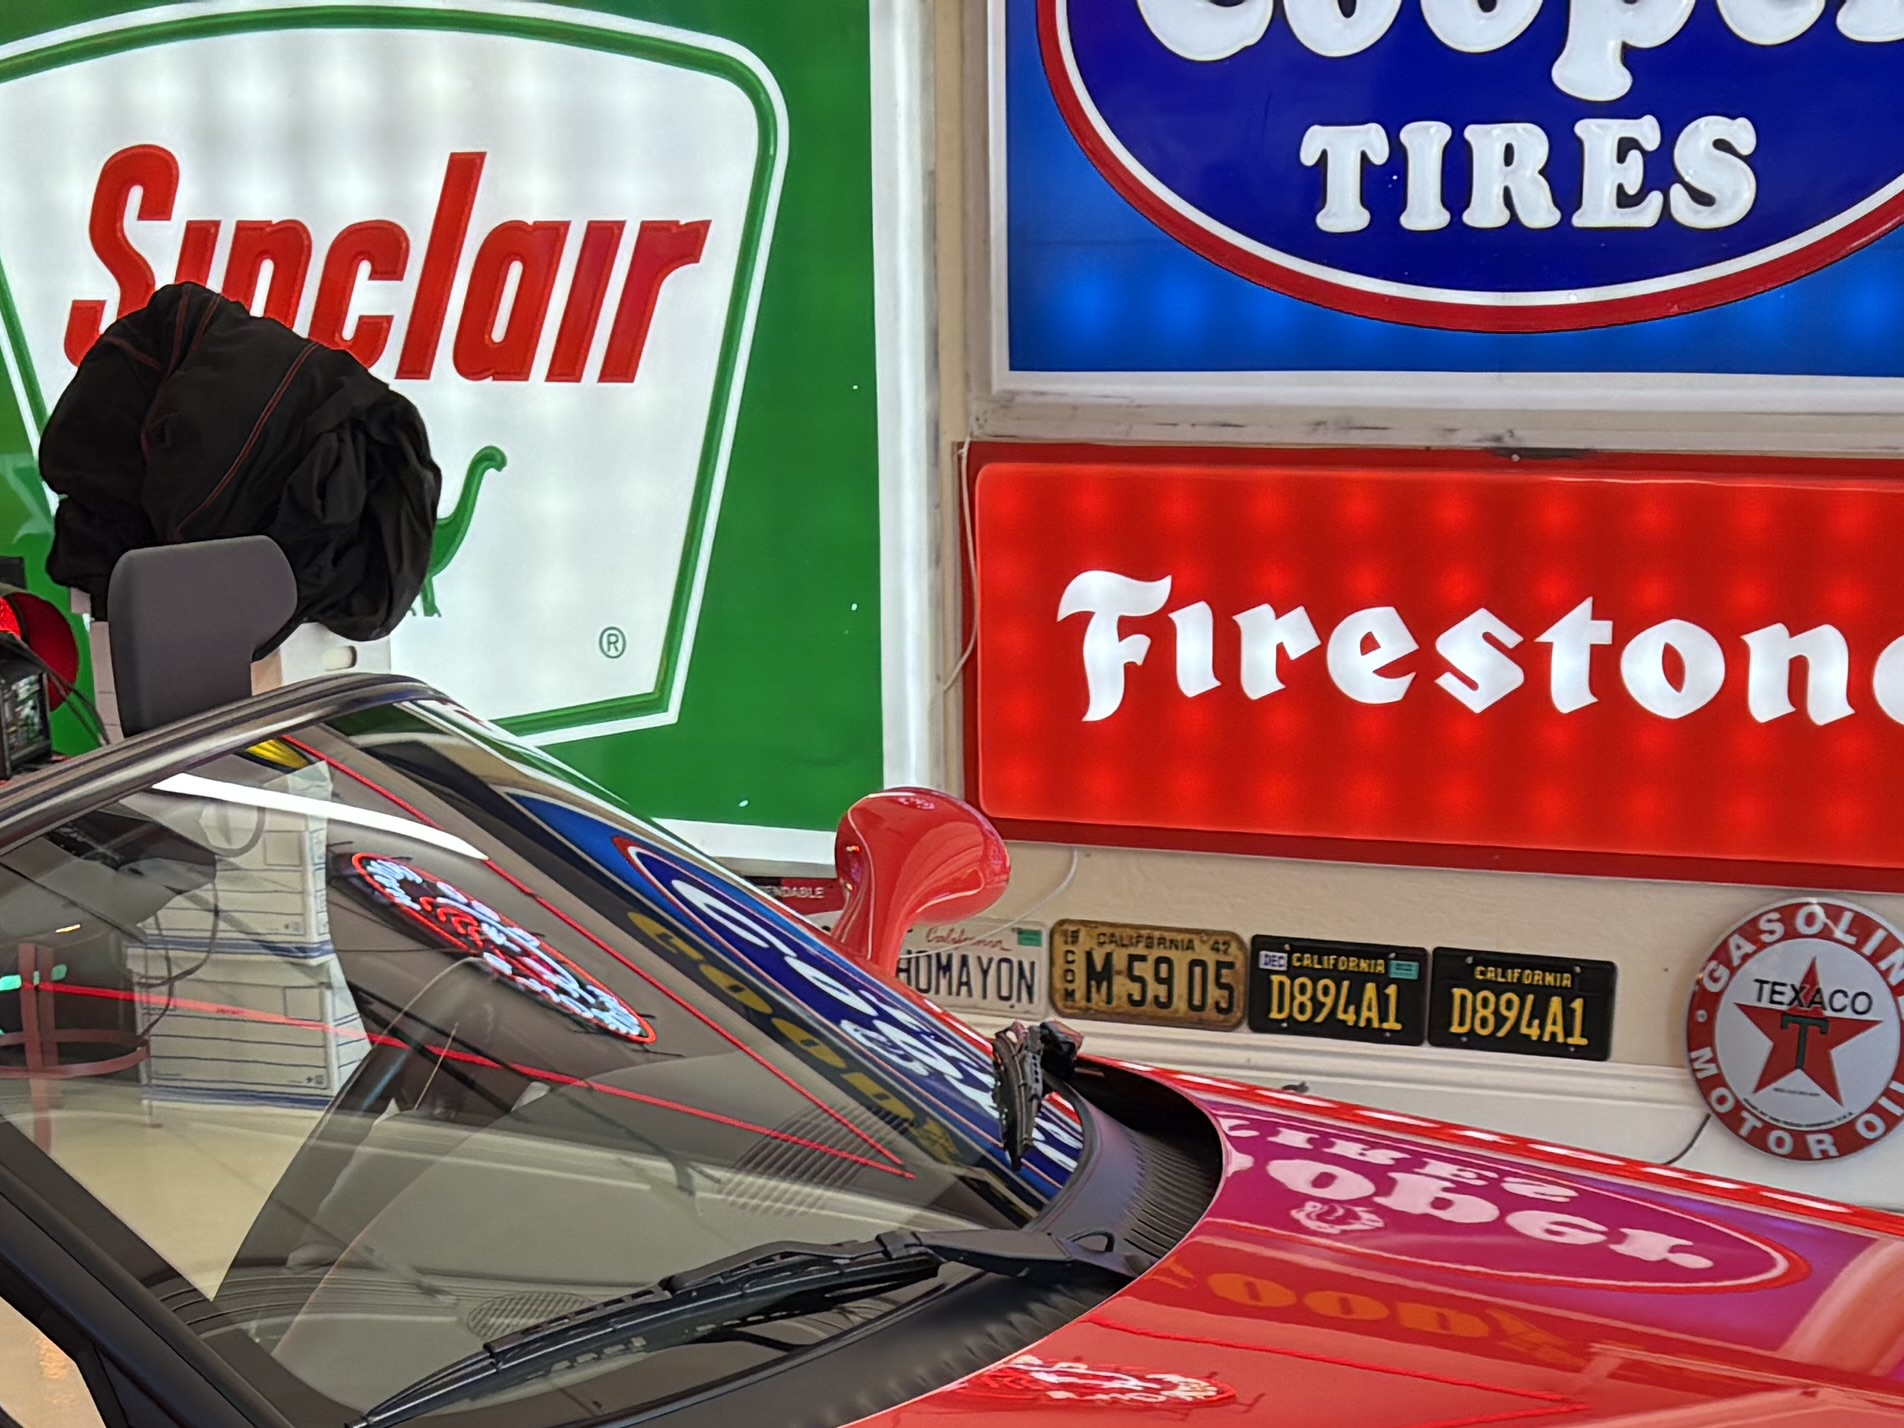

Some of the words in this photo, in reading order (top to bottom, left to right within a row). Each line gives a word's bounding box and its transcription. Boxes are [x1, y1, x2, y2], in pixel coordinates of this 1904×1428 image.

[1300, 114, 1757, 234] TIRES
[1096, 932, 1196, 952] CALIFORNIA
[1291, 953, 1386, 975] CALIFORNIA
[1474, 965, 1572, 988] CALIFORNIA
[1753, 978, 1873, 1016] TEXACO
[1268, 974, 1403, 1031] D894A1
[1450, 987, 1589, 1046] D894A1
[1690, 1047, 1839, 1160] MOTOR
